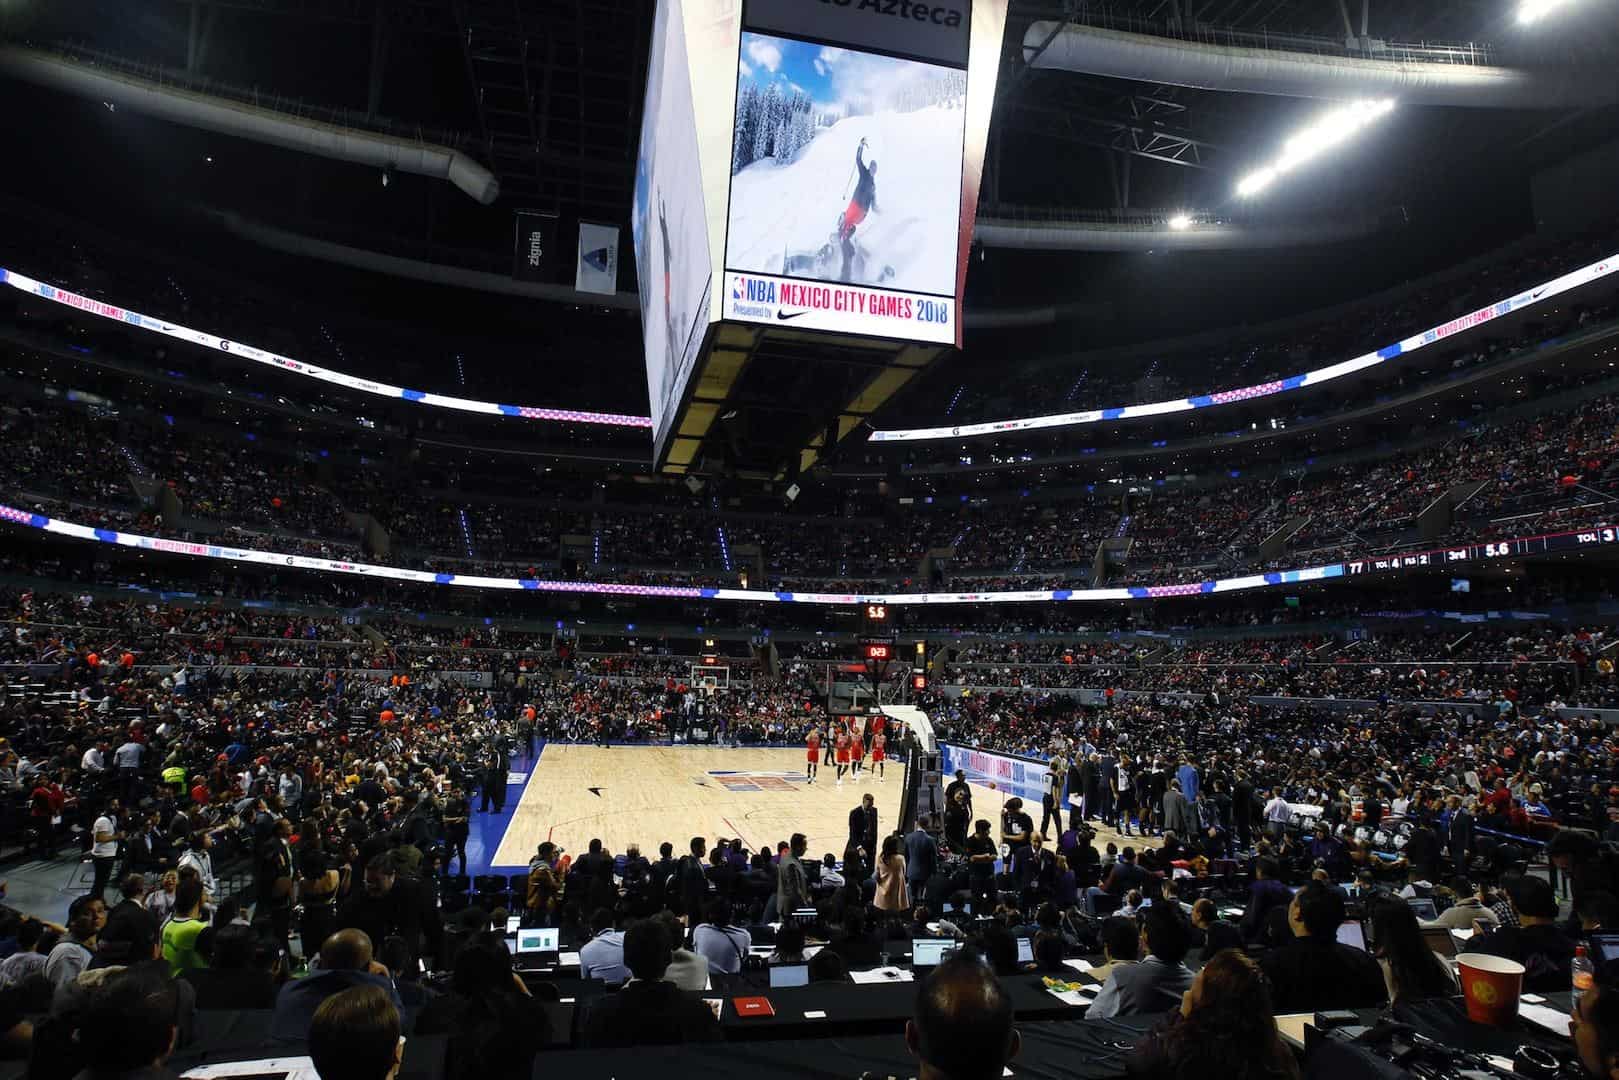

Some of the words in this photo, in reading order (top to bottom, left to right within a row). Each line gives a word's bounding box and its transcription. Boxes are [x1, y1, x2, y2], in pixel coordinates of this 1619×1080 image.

[528, 231, 543, 267] zignia
[747, 279, 775, 304] NBA
[780, 283, 830, 310] MEXICO
[834, 290, 866, 313] CITY
[869, 294, 912, 319] GAMES
[917, 299, 948, 324] 2018
[1576, 533, 1597, 544] TOL
[1602, 530, 1615, 542] 3
[1448, 549, 1466, 560] 3rd
[1485, 542, 1509, 558] 5.6
[1391, 558, 1400, 568] 4
[1420, 555, 1428, 565] 2
[1350, 562, 1363, 574] 77
